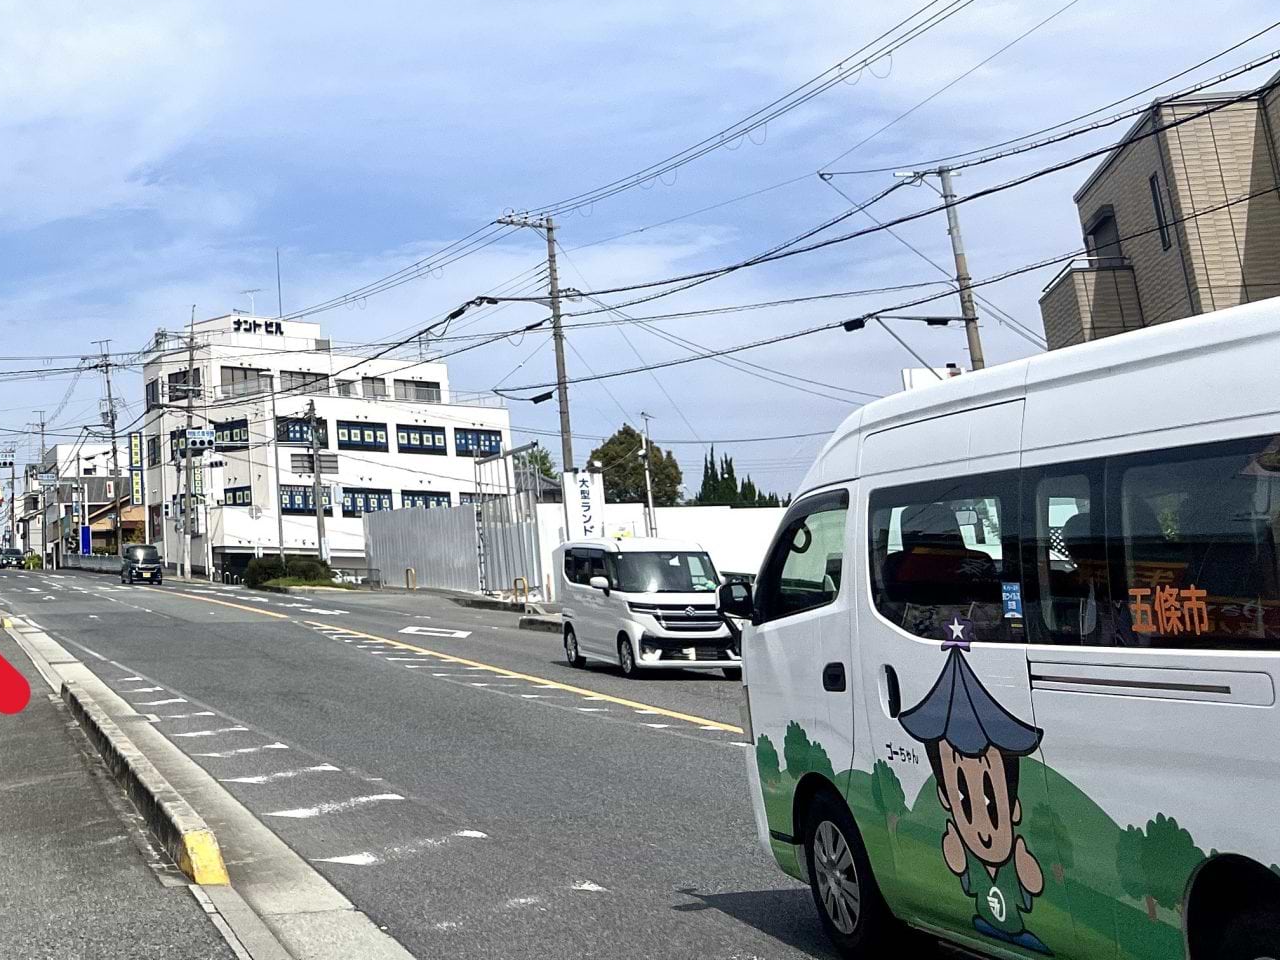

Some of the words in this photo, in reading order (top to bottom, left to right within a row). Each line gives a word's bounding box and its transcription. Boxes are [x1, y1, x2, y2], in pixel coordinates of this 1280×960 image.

[578, 478, 595, 536] 大型ランド
[1128, 584, 1209, 636] 五條市
